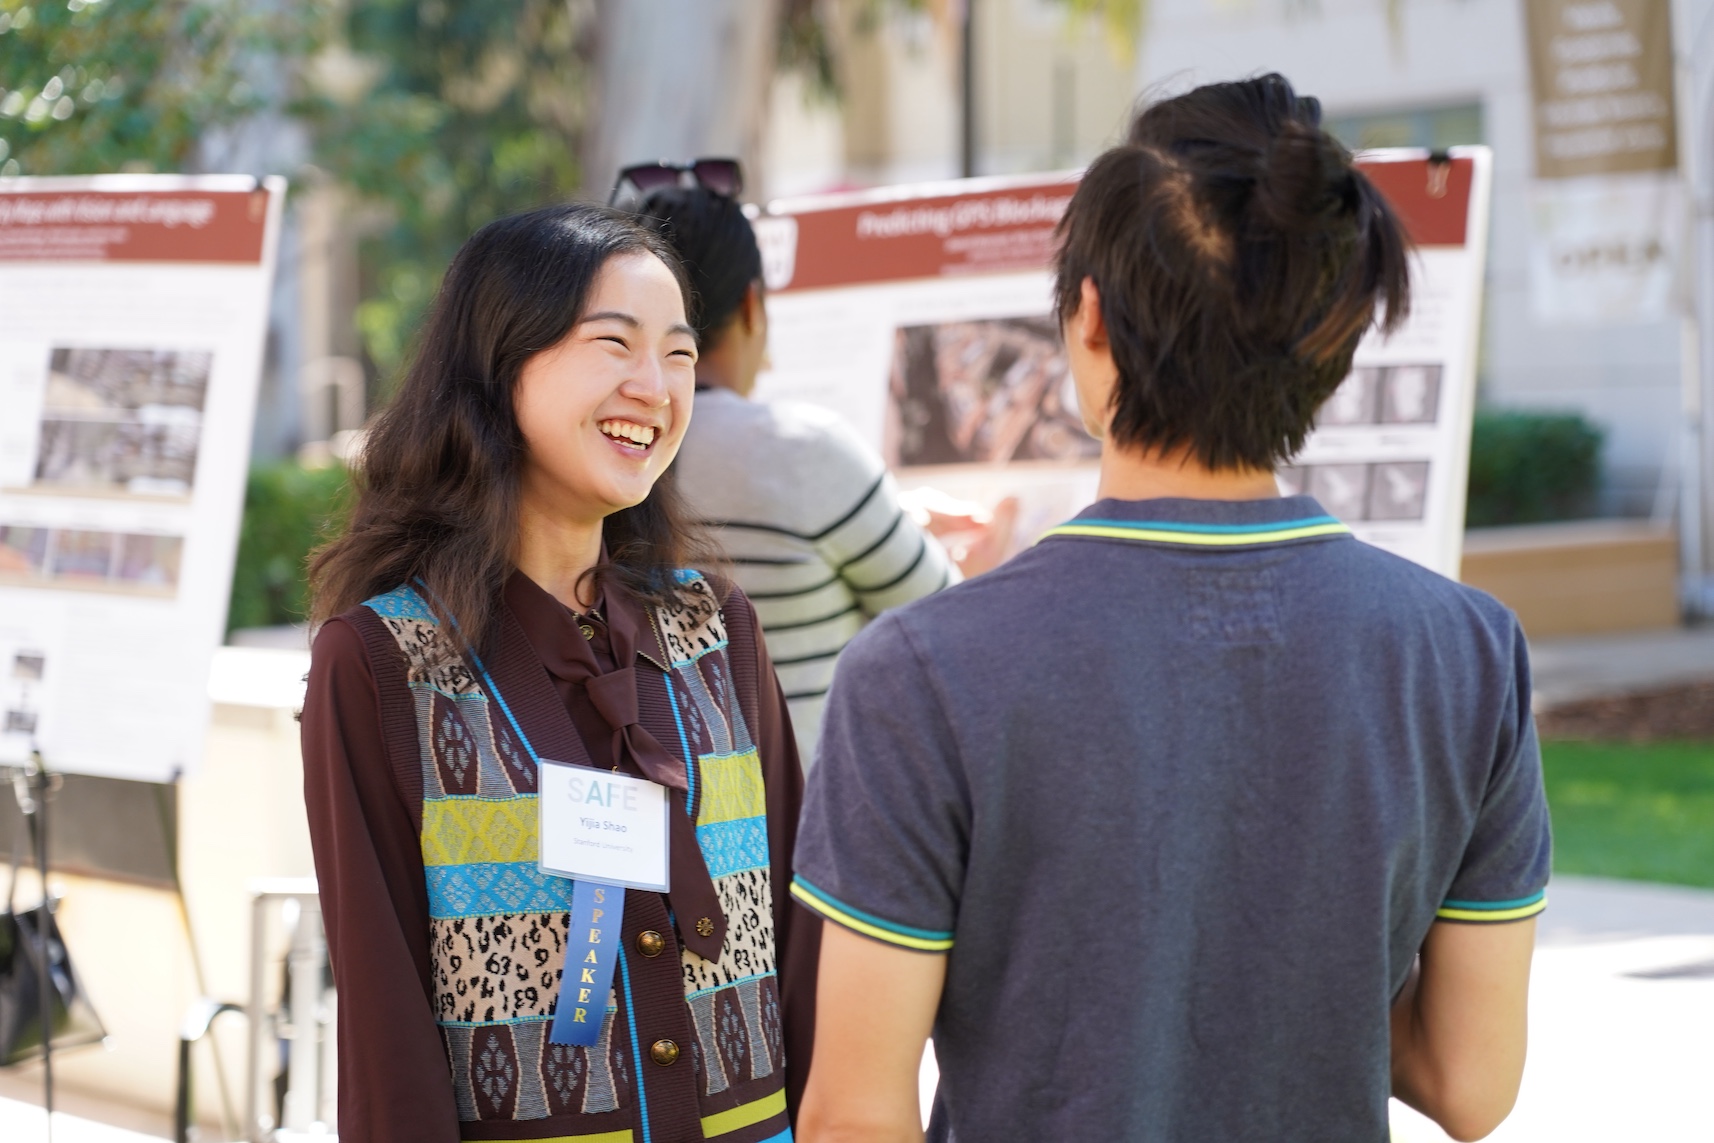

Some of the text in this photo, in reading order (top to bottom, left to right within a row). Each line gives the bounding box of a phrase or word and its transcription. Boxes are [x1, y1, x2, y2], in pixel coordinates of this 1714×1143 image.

[857, 207, 952, 238] Predicting
[568, 777, 638, 811] SAFE
[579, 816, 628, 833] Yijia Shao
[572, 837, 634, 853] Stanford University
[573, 888, 606, 1023] SPEAKER
